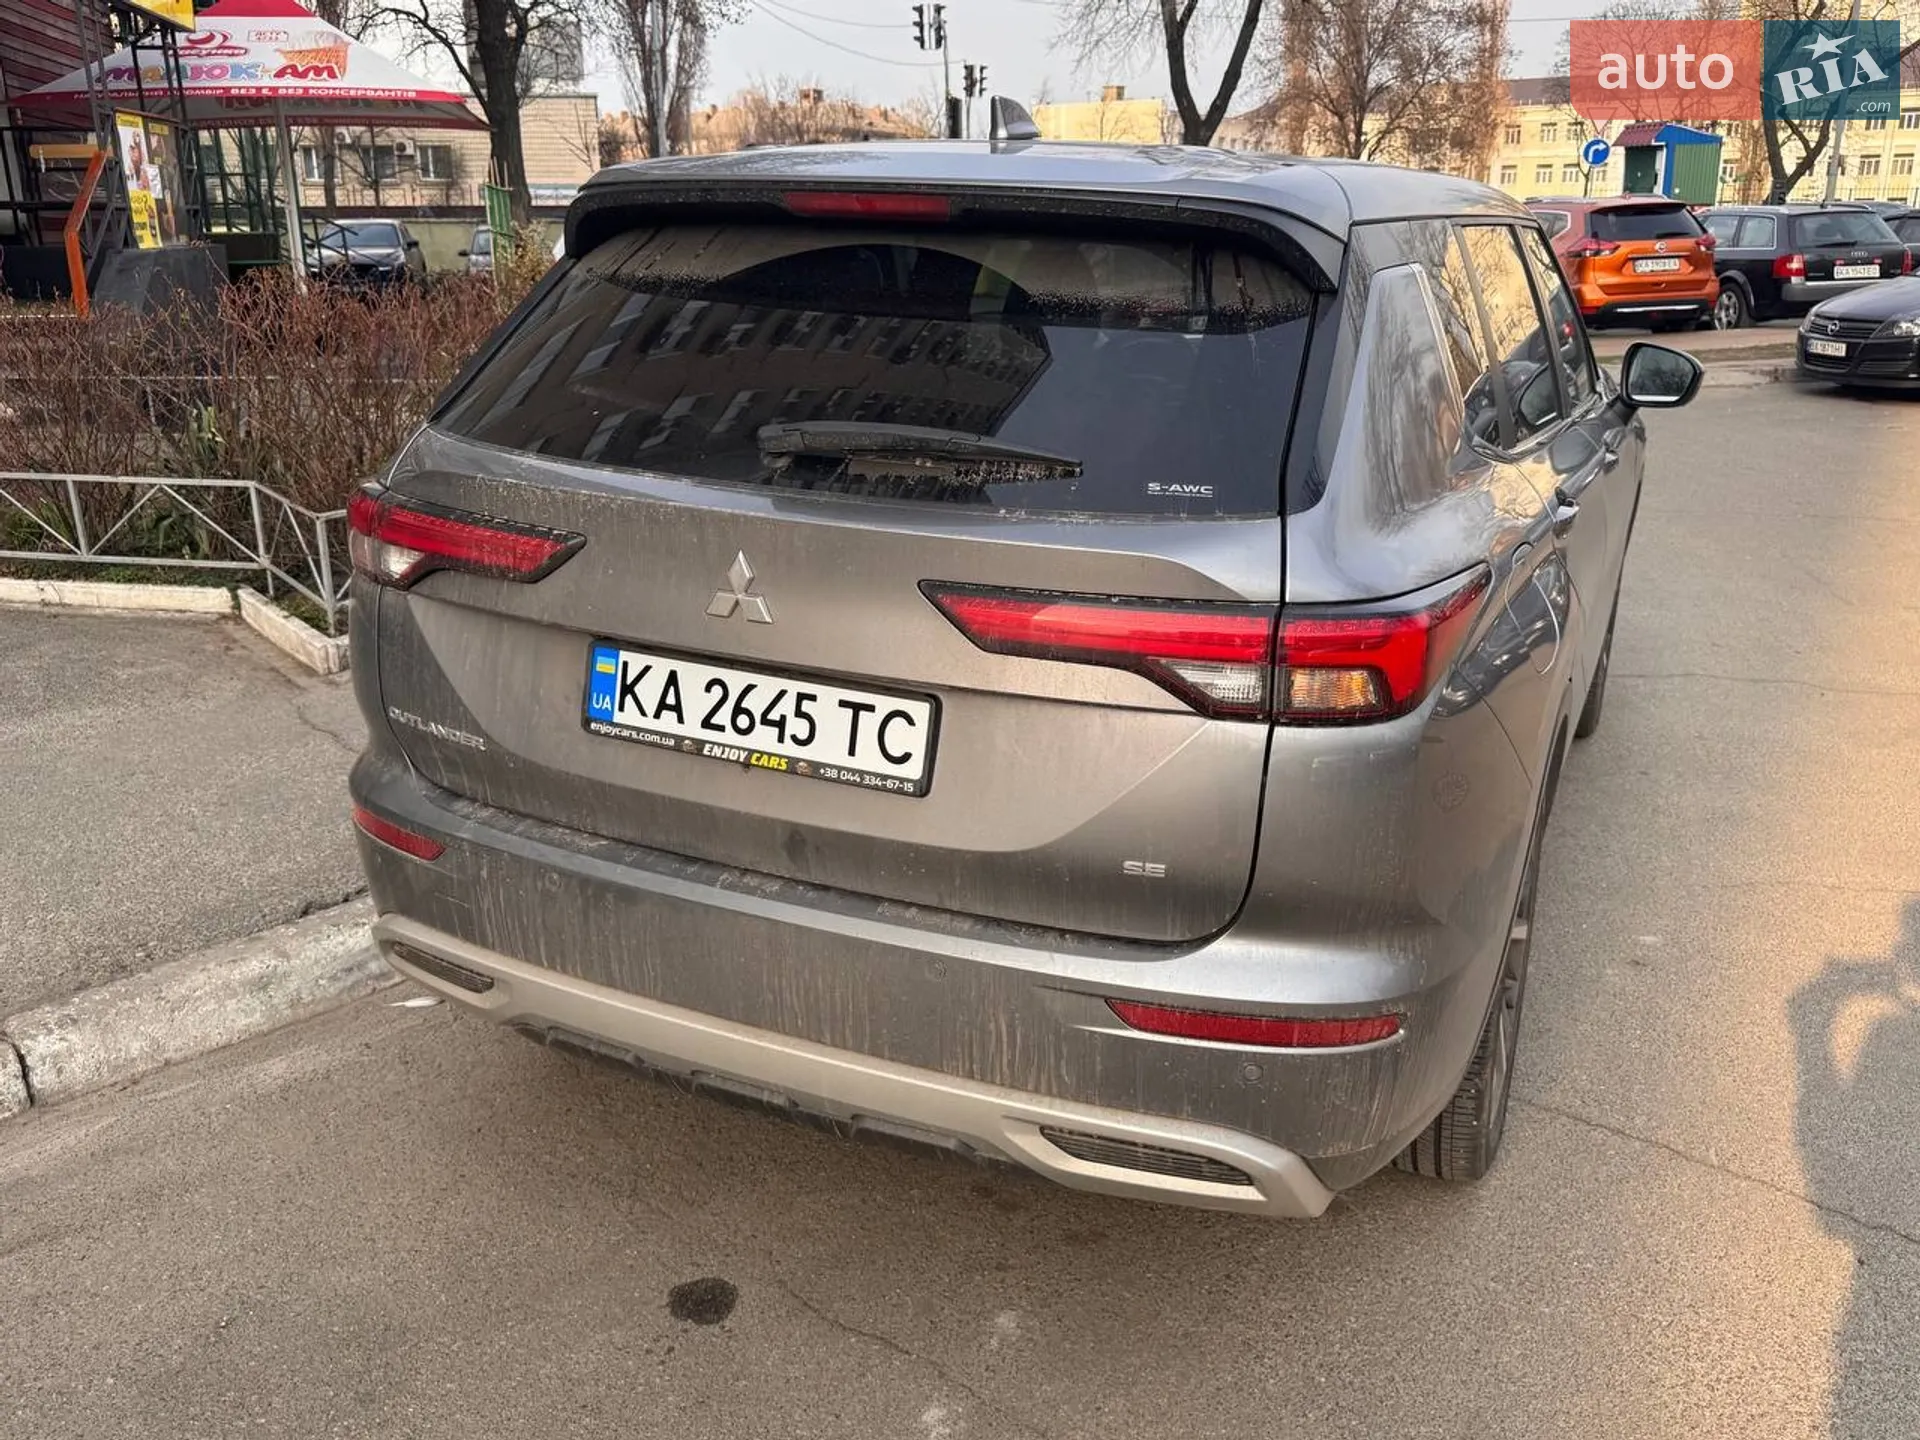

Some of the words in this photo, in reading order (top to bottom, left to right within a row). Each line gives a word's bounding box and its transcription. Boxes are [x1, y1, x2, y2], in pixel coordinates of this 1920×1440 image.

[1147, 482, 1213, 495] S-AWC
[592, 692, 612, 711] UA
[618, 660, 685, 725] KA
[700, 677, 818, 748] 2645
[838, 698, 916, 766] TC
[389, 706, 487, 751] OUTLANDER
[590, 721, 675, 747] enjoycars.com.ua
[702, 742, 749, 763] ENJOY
[750, 752, 789, 771] CARS
[819, 766, 838, 779] +38
[840, 770, 861, 783] 044
[863, 774, 914, 793] 334-67-15
[1123, 860, 1166, 877] SE
